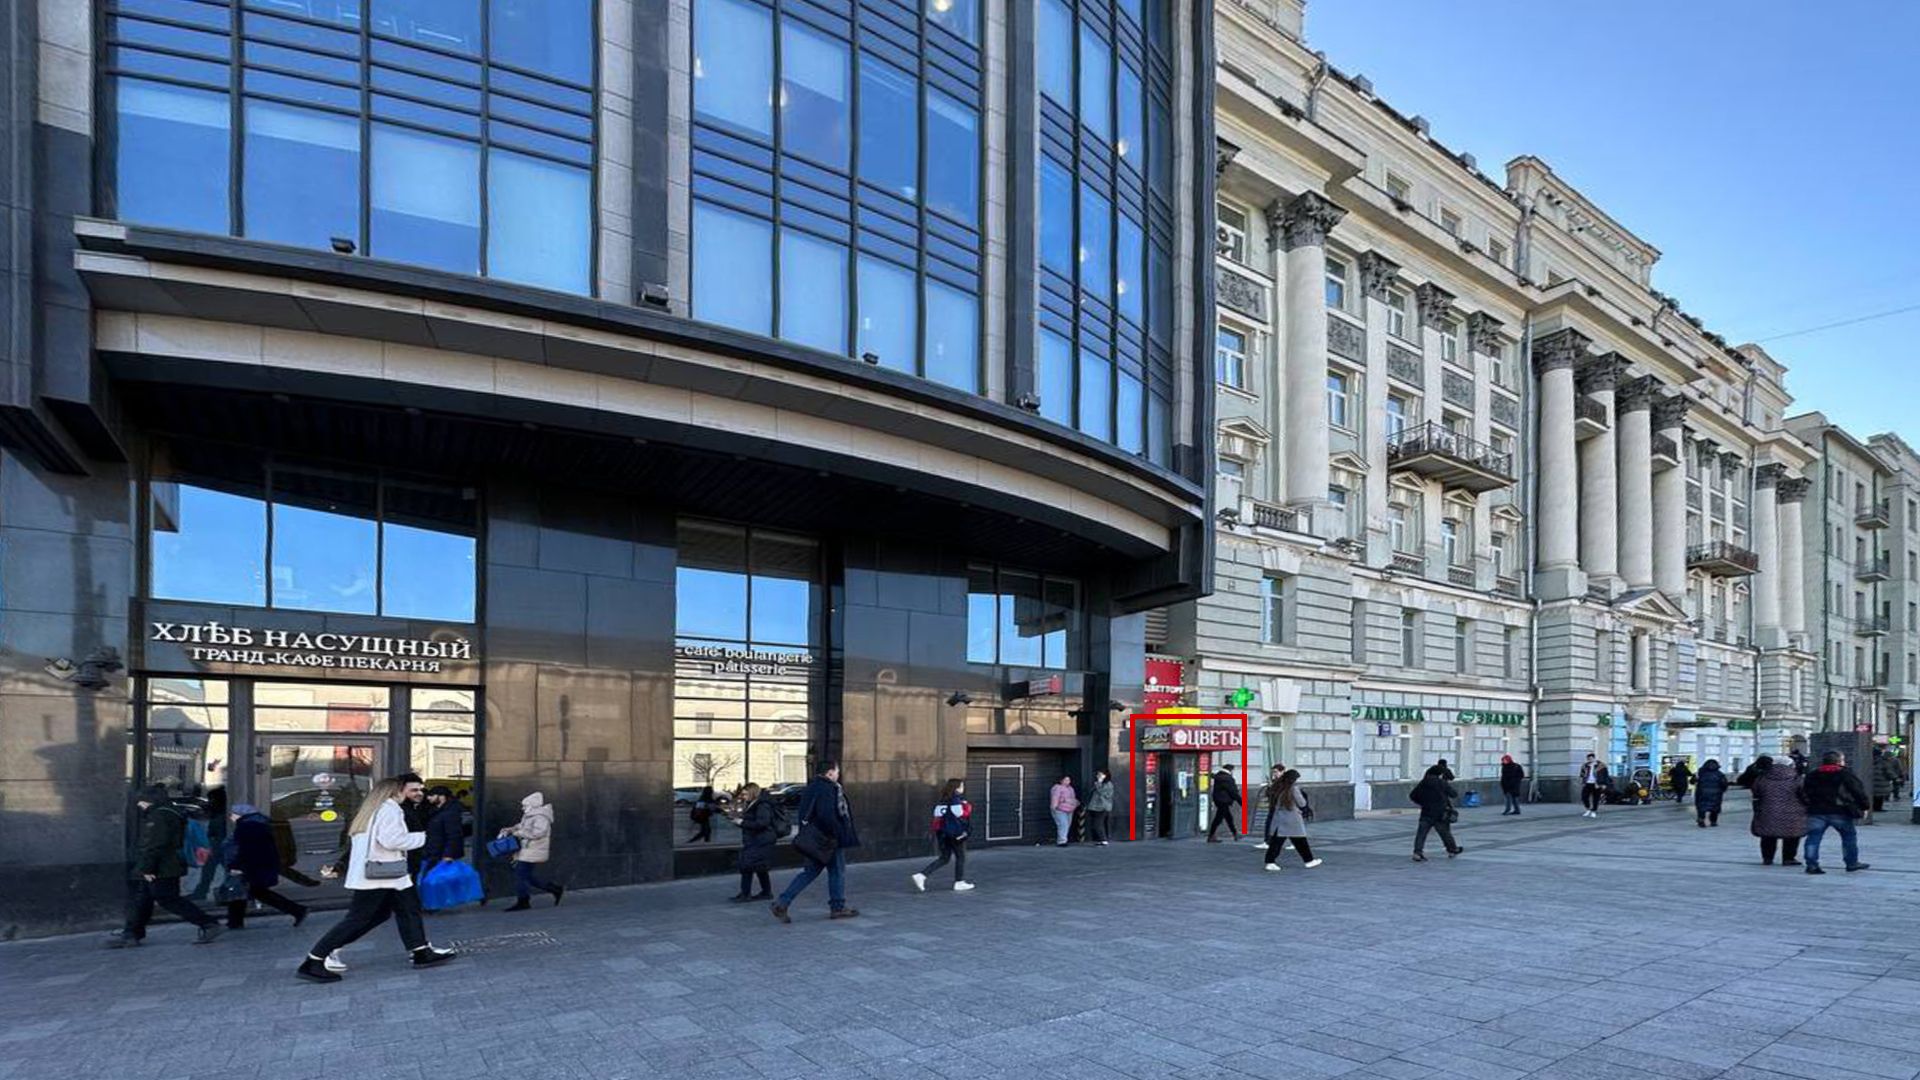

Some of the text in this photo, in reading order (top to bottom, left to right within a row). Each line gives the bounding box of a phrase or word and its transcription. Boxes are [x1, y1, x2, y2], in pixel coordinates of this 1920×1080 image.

[264, 629, 472, 660] НАСУЩНЫЙ
[724, 647, 814, 664] boulangerie
[192, 646, 442, 673] ГРАНД-КАФЕ ПЕКАРНЯ
[714, 660, 787, 676] pâtisserie
